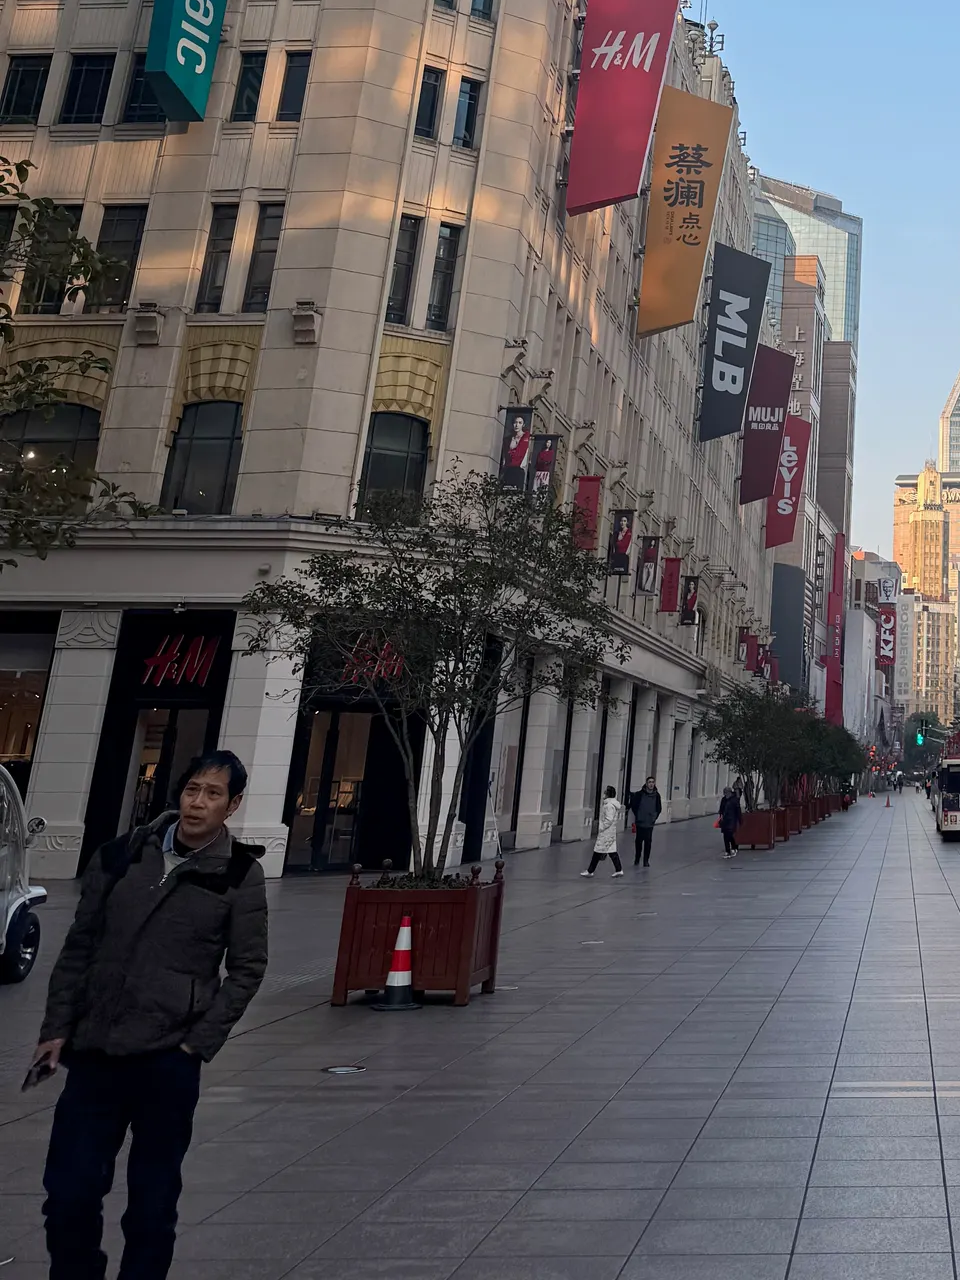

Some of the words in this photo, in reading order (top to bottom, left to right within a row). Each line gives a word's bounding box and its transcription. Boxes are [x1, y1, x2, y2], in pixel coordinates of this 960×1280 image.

[590, 30, 661, 73] H&M
[711, 289, 750, 396] MLB
[748, 406, 784, 423] MUJI
[141, 634, 221, 687] H&M
[880, 615, 896, 659] KFC
[899, 603, 909, 677] BOSIDENG
